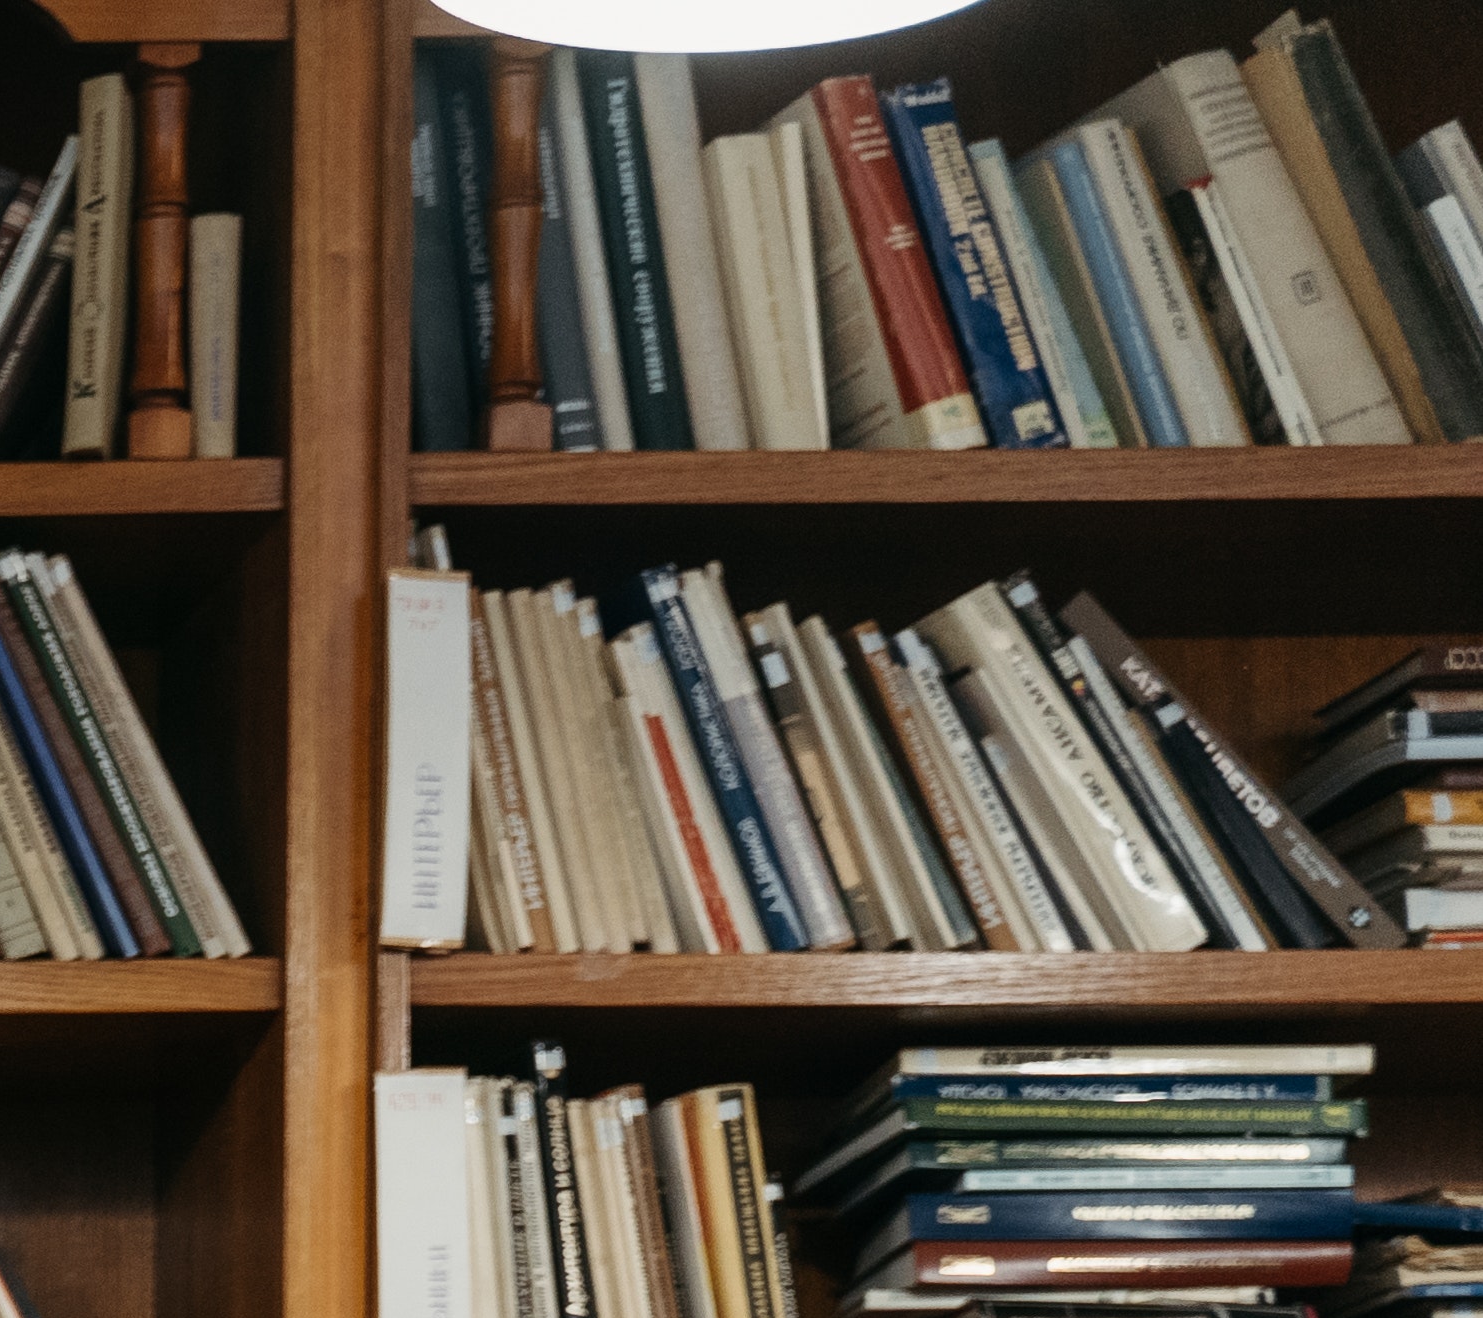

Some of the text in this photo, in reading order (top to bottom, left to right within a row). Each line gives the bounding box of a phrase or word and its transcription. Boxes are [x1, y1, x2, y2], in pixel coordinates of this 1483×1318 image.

[604, 77, 668, 396] Гидротехнические сооружения
[687, 679, 741, 791] КОЛОРИСТИКА
